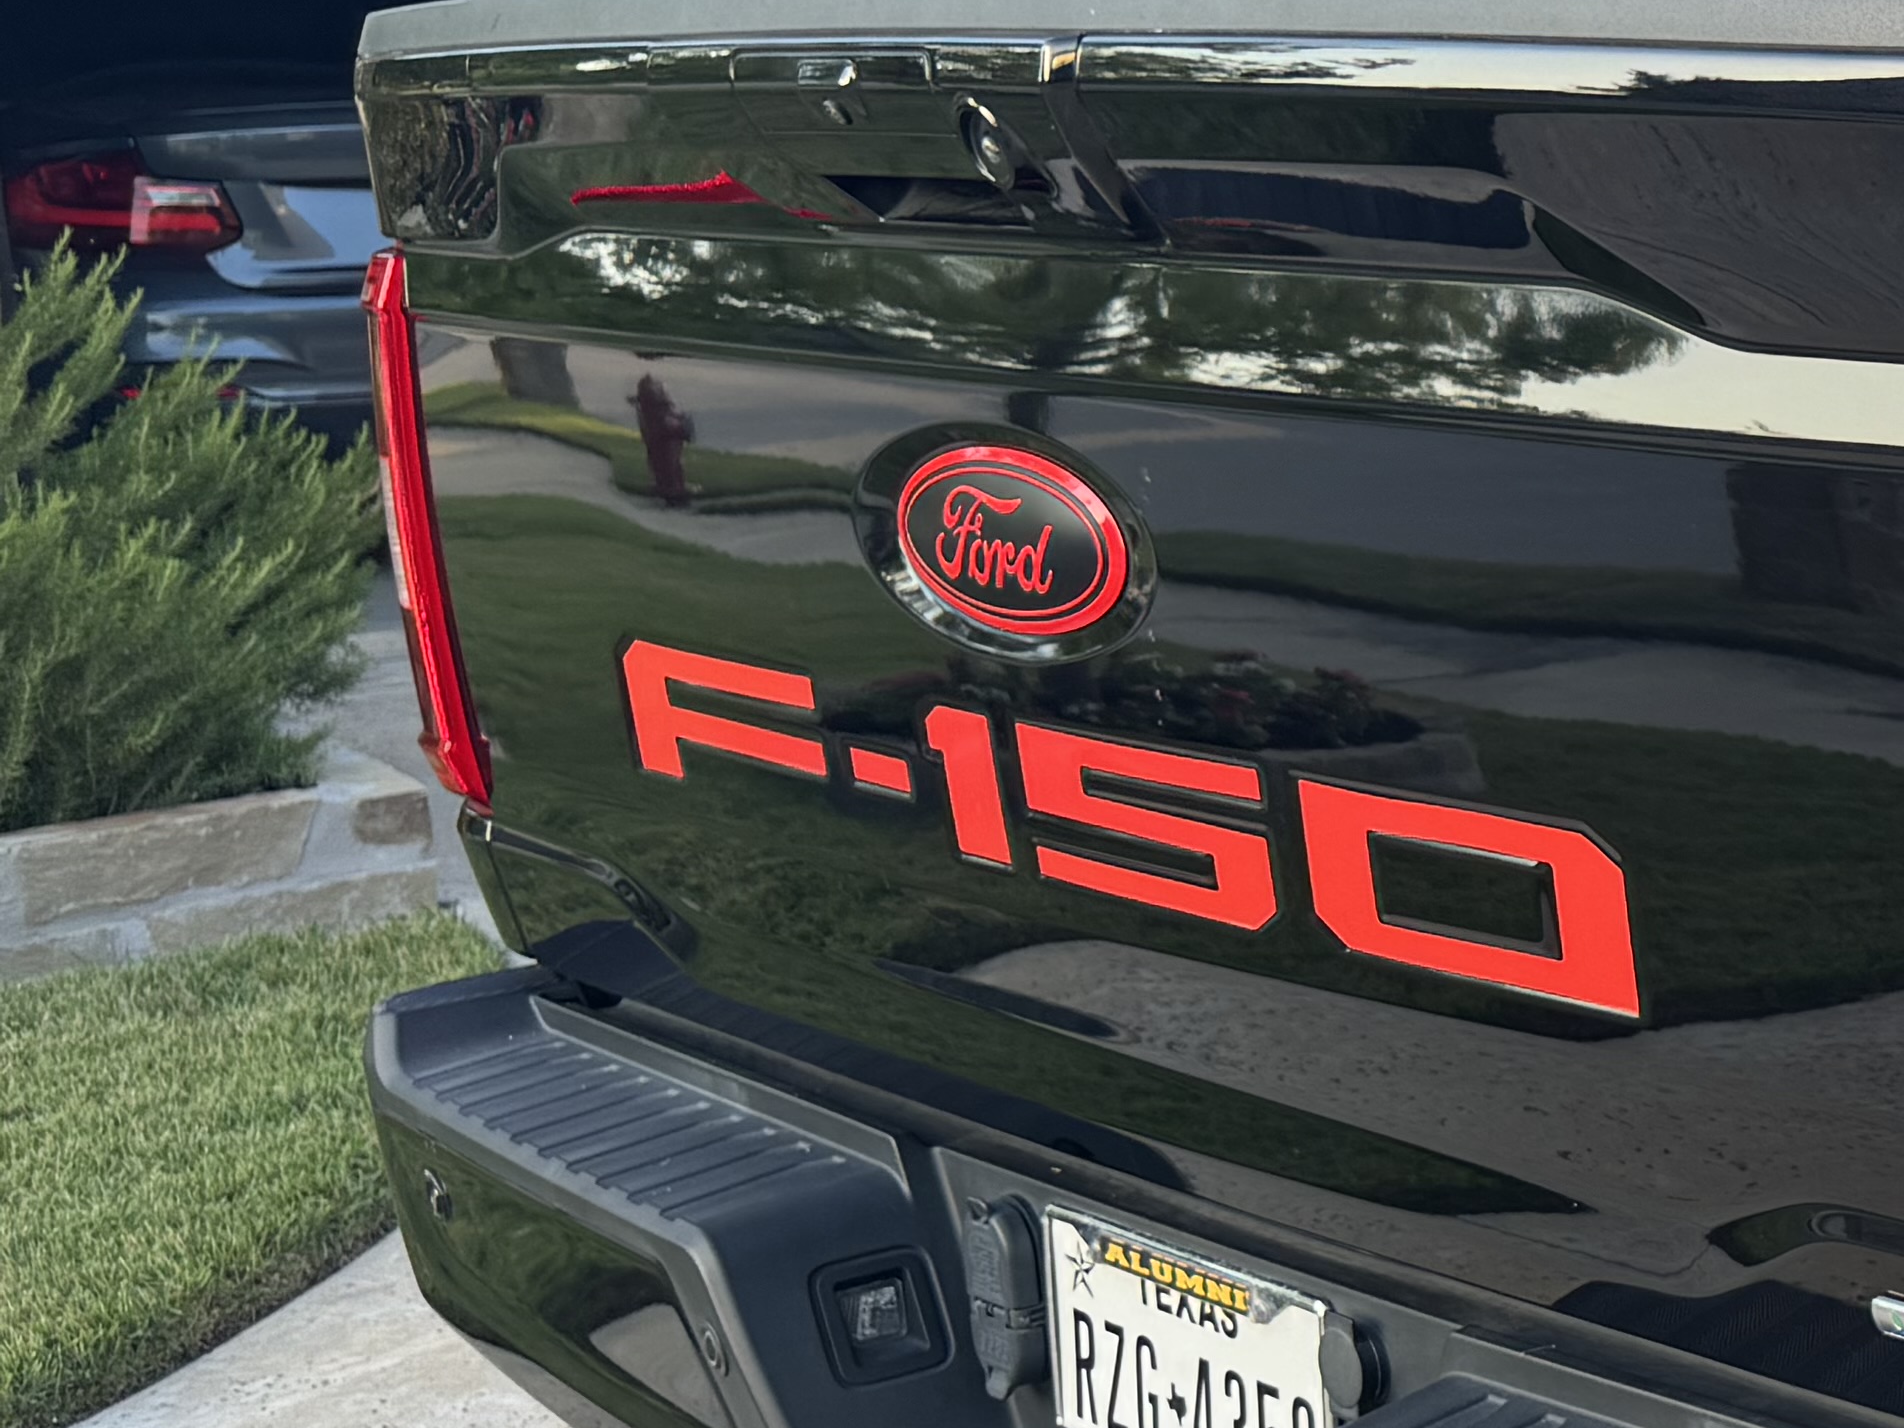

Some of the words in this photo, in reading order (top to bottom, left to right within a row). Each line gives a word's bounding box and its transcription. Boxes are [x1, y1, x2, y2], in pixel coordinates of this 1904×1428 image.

[935, 484, 1054, 595] Ford
[622, 638, 1640, 1019] F-150
[1104, 1242, 1249, 1312] ALUMNI
